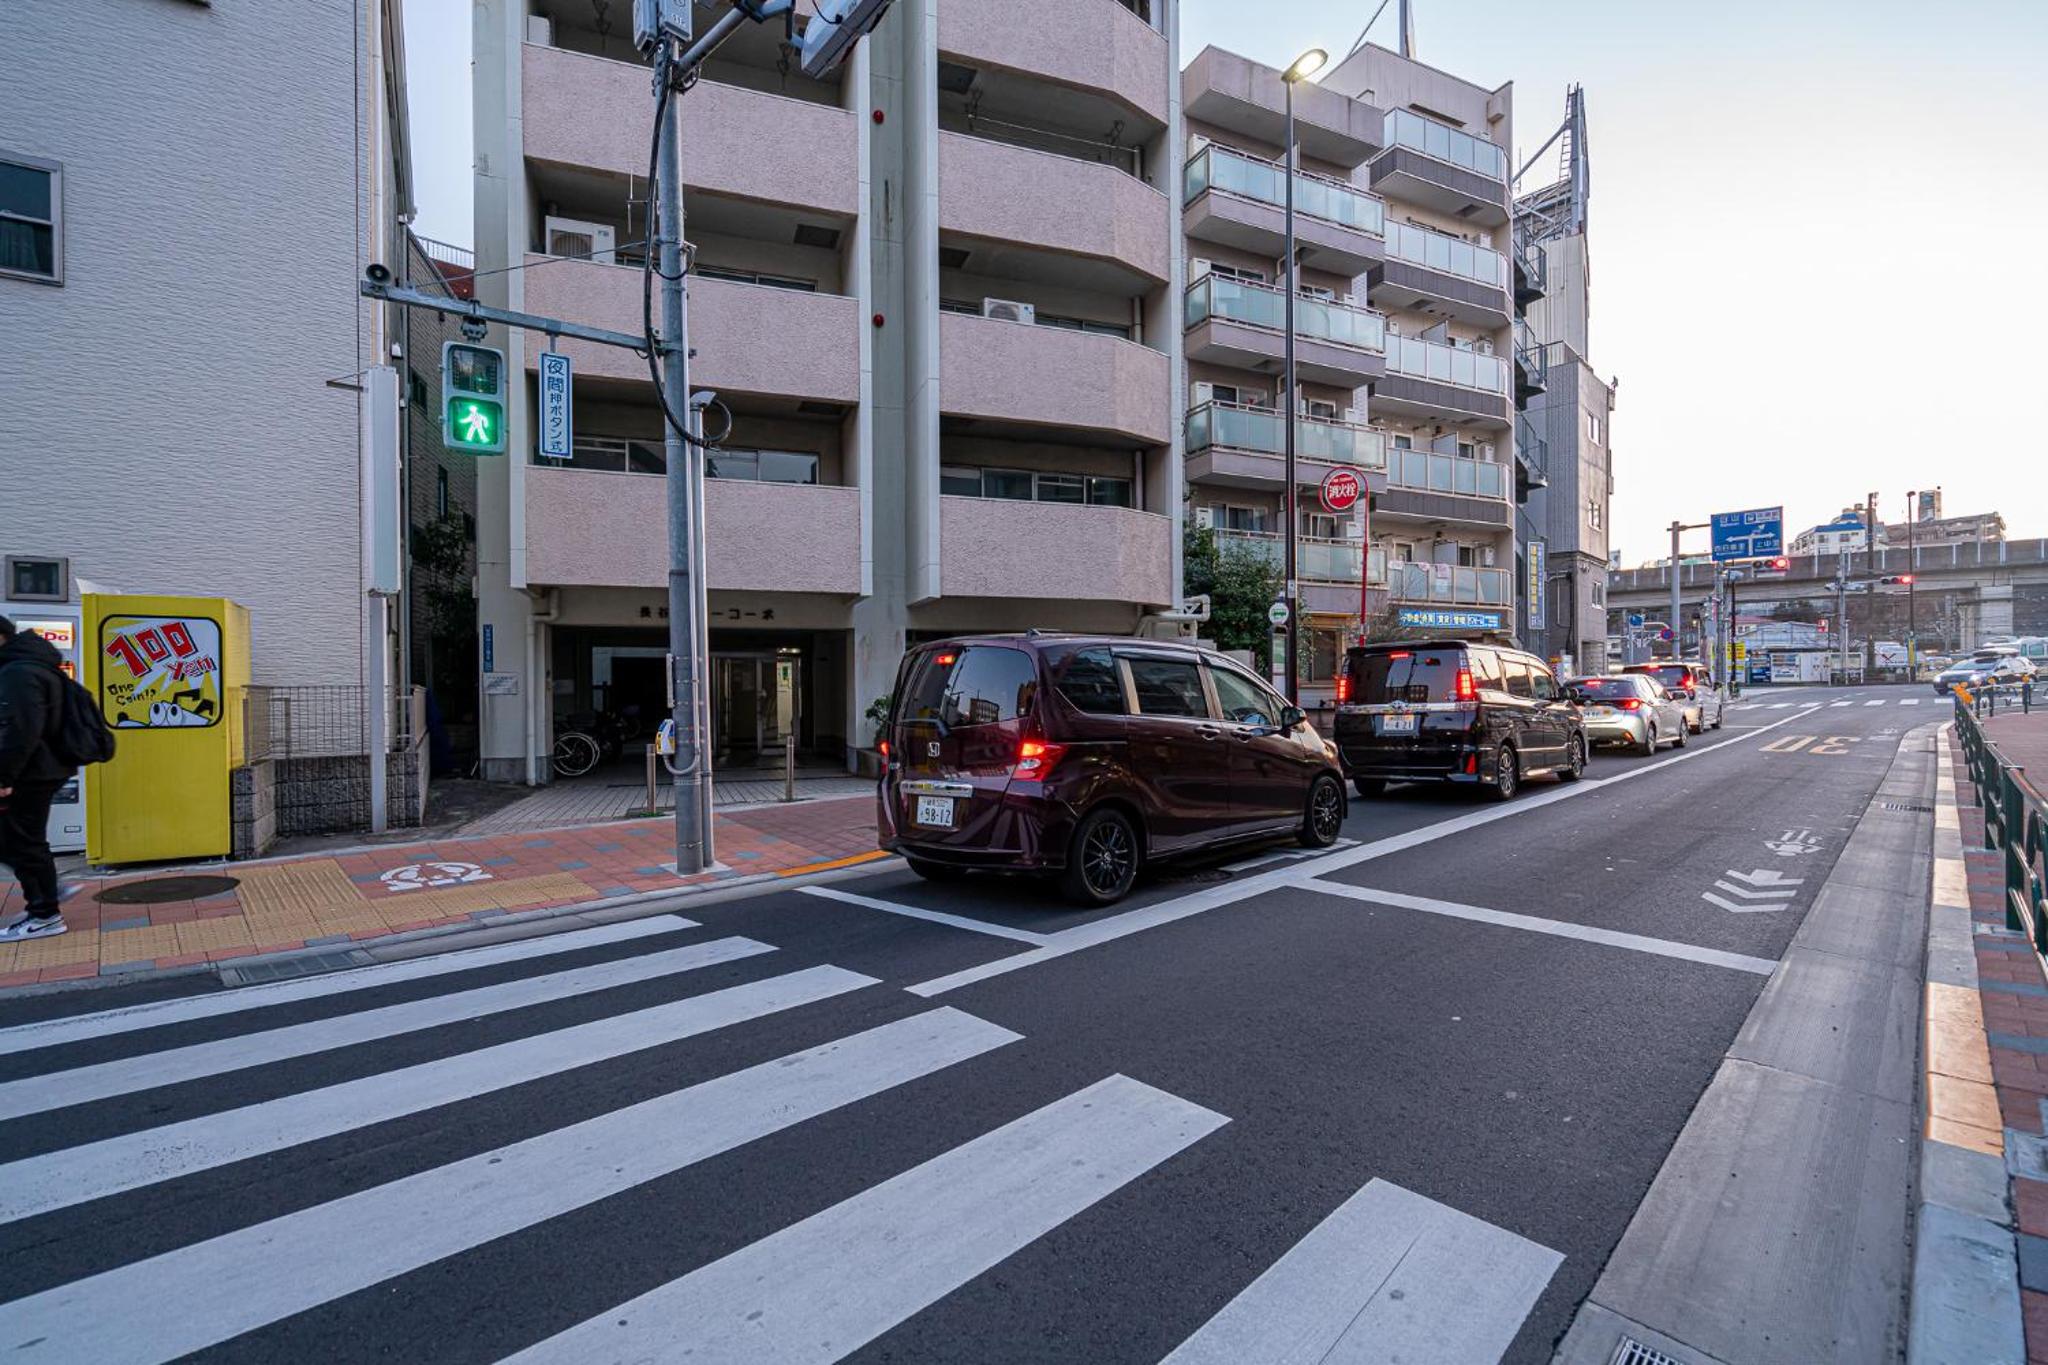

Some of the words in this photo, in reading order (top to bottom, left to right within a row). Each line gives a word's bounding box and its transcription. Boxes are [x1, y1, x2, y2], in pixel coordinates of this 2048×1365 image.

[547, 359, 564, 452] 夜間押ボタン式
[1329, 481, 1357, 499] 消火栓
[105, 622, 197, 677] 100
[164, 654, 217, 682] yen
[107, 683, 135, 696] One
